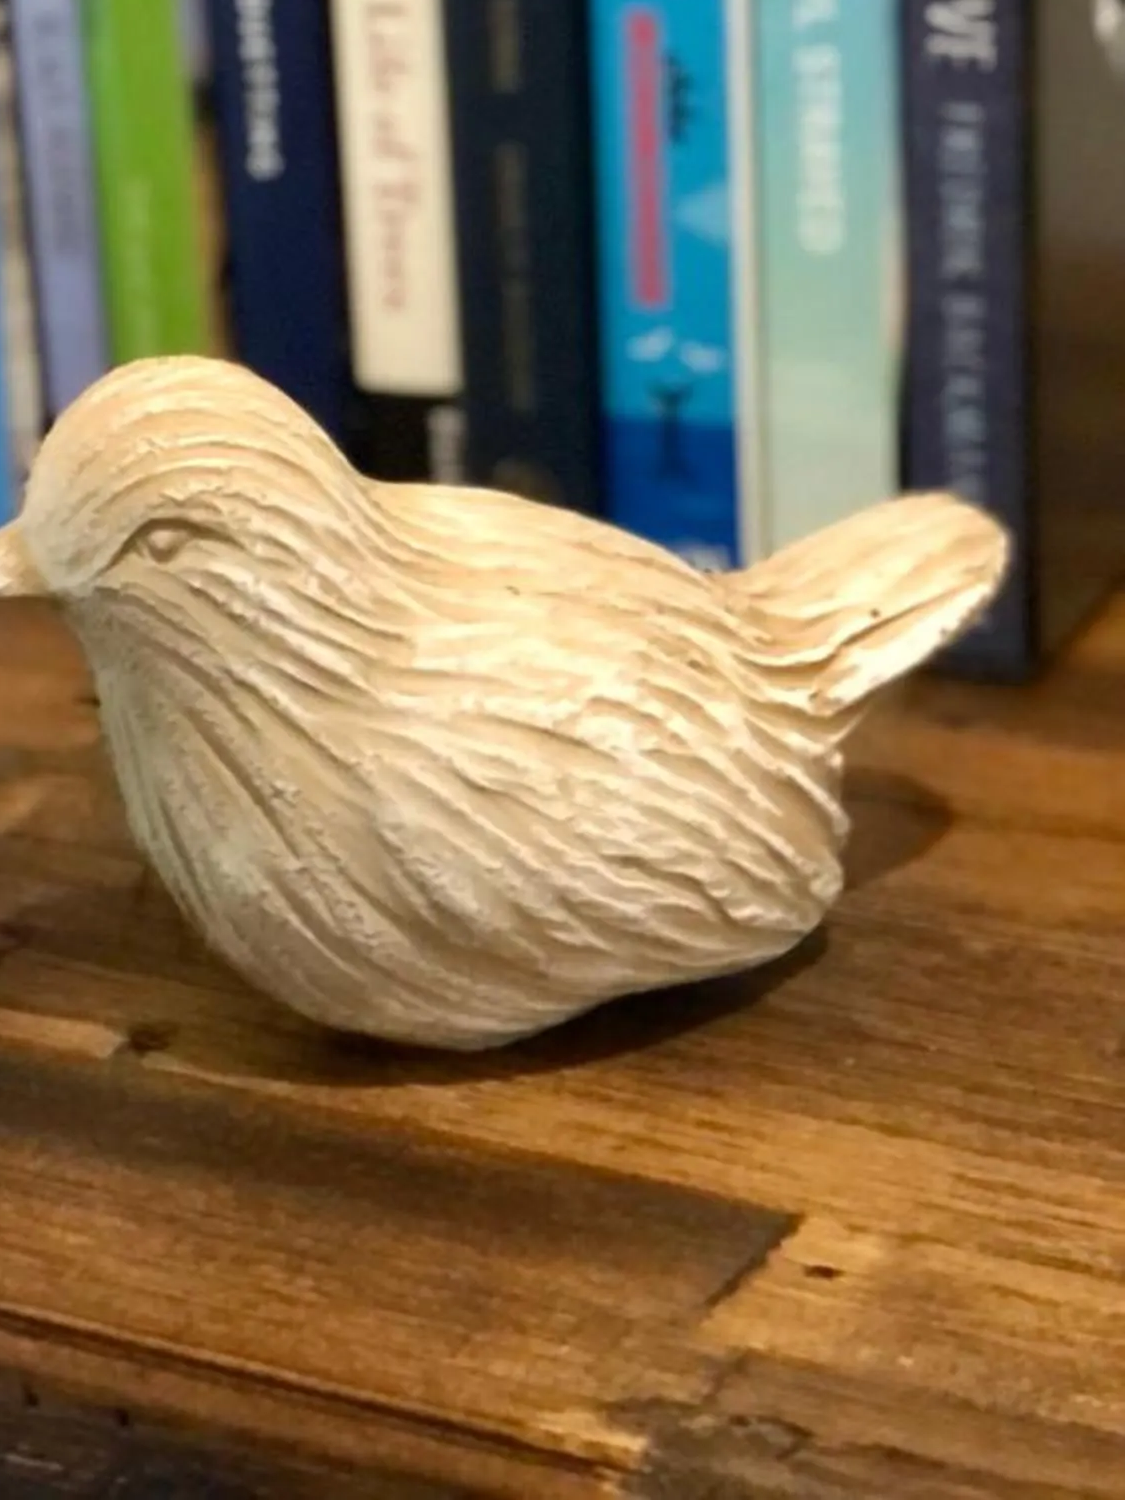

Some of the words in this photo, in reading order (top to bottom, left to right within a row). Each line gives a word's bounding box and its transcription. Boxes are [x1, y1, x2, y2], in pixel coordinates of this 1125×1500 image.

[363, 0, 410, 96] Life
[370, 110, 421, 166] of
[375, 179, 423, 315] Trees
